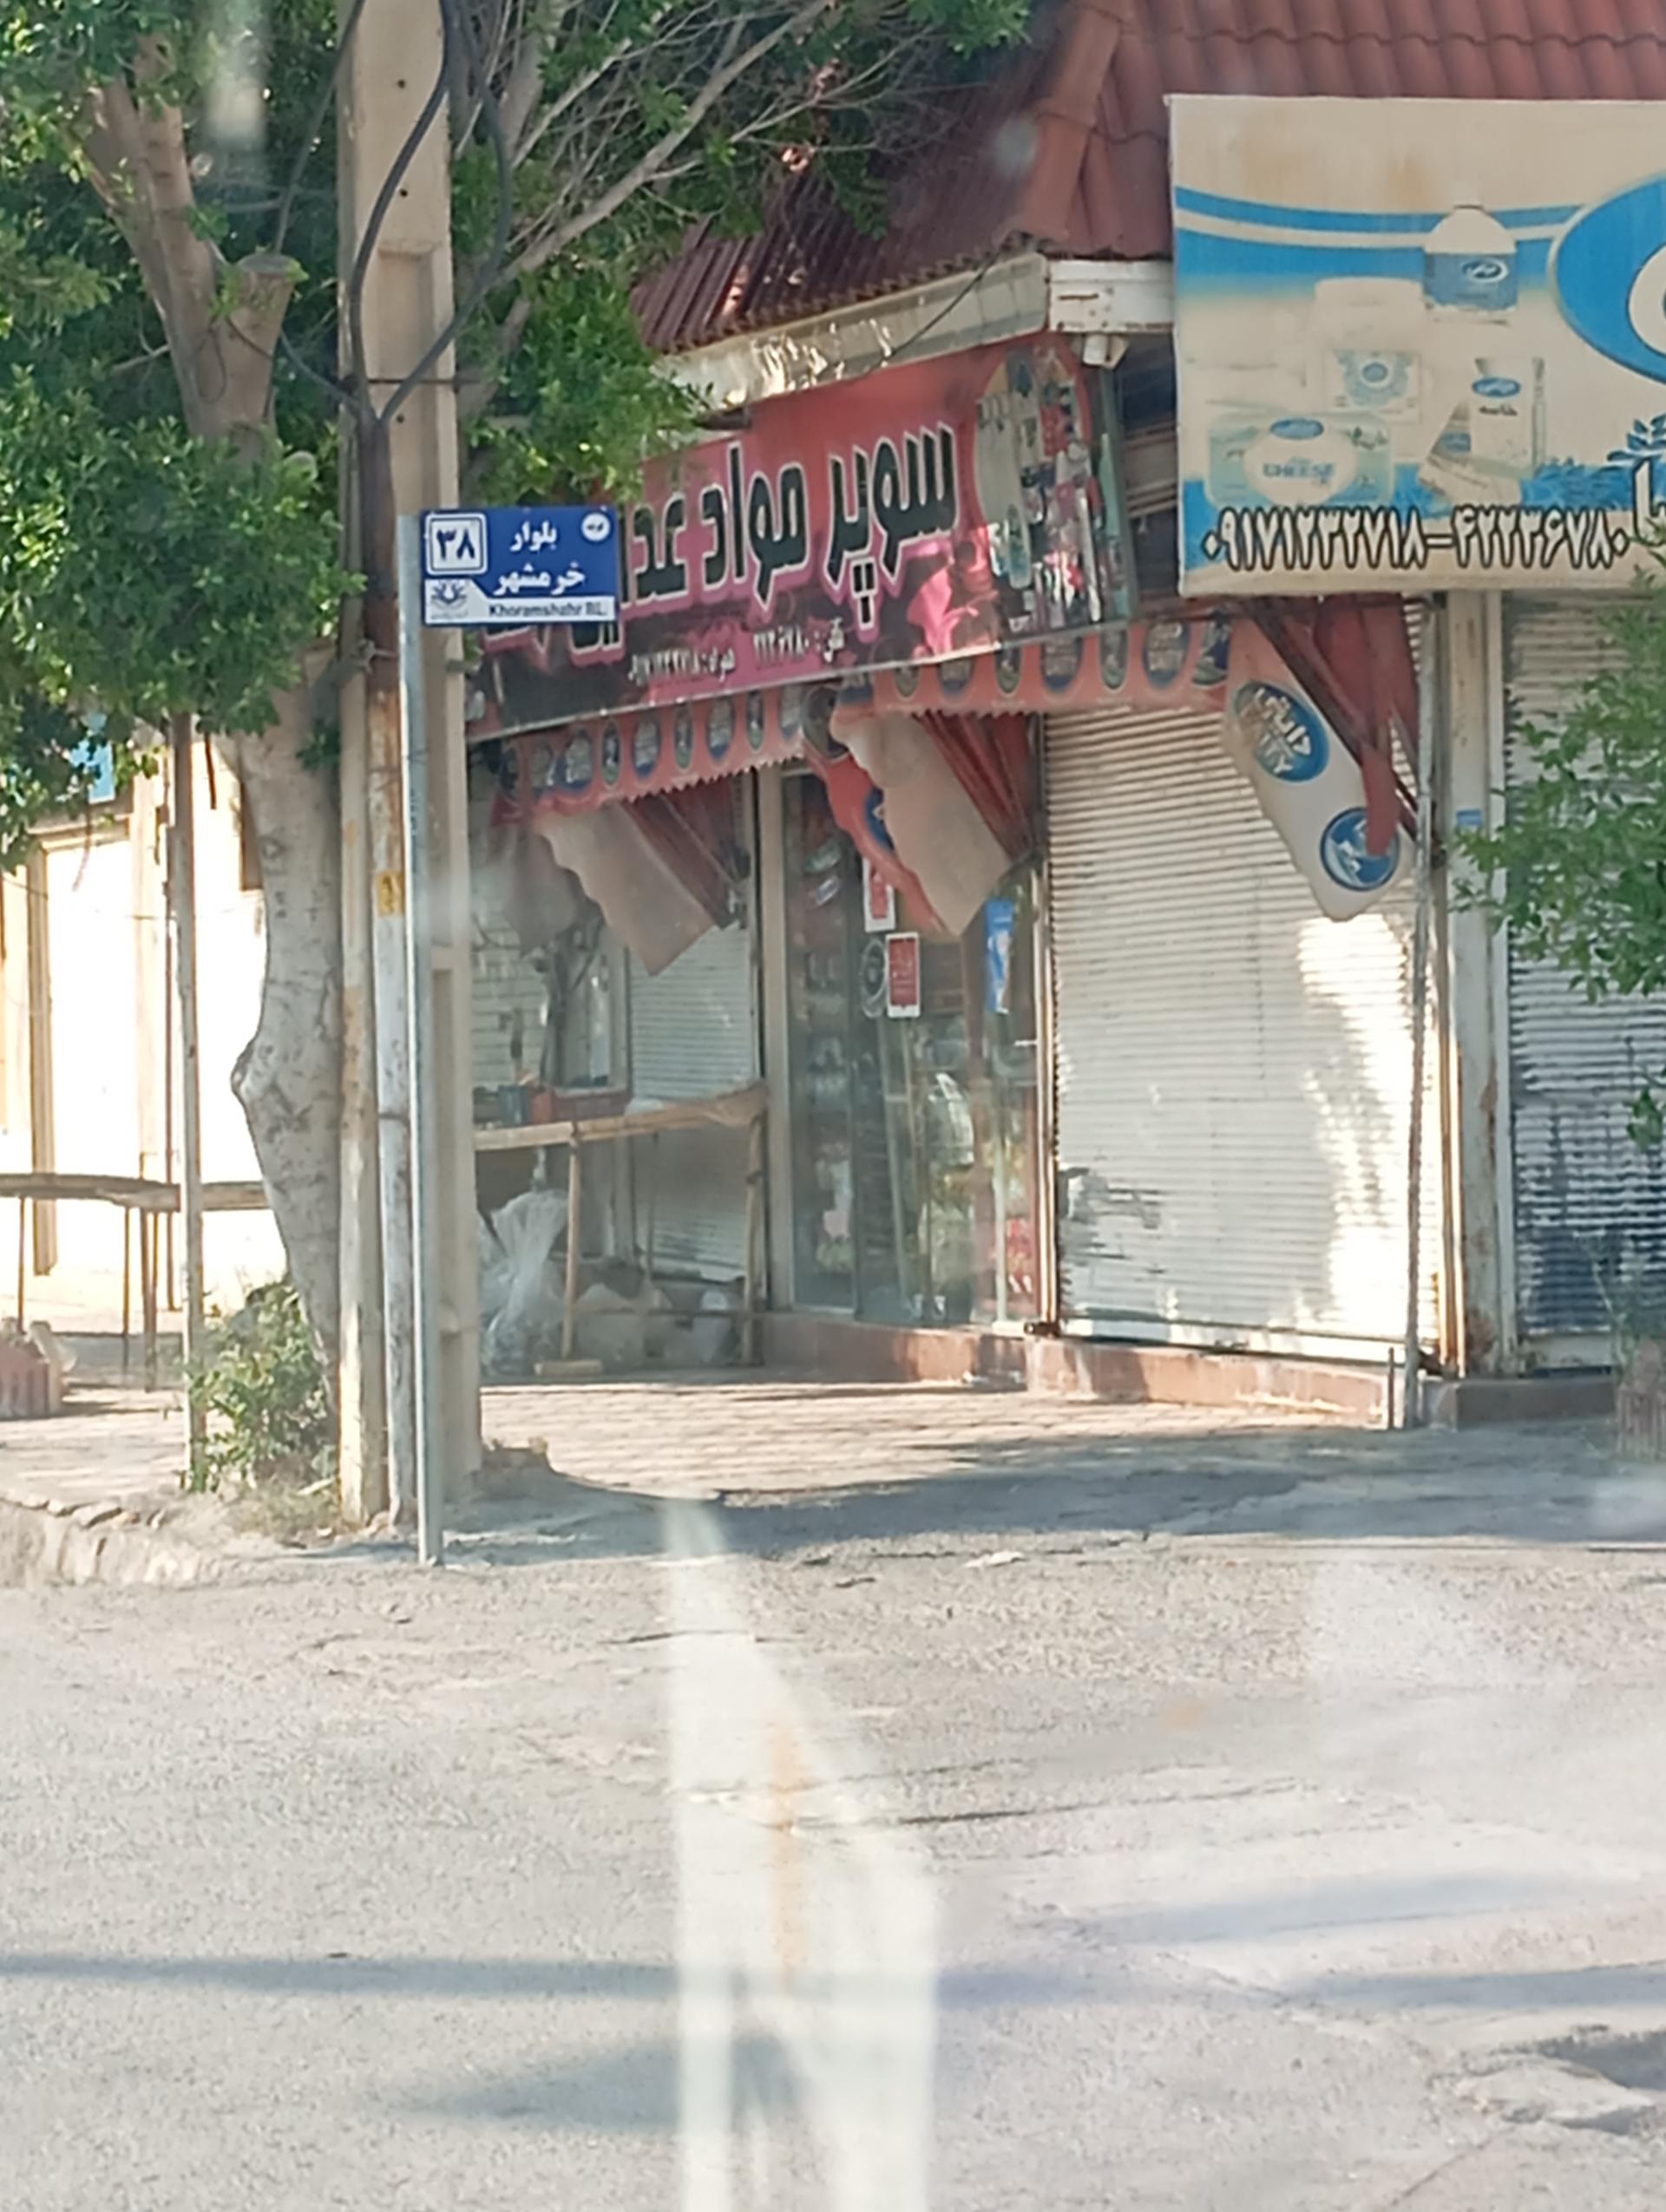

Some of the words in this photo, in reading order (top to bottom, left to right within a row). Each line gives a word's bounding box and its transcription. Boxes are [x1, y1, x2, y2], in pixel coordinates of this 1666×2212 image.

[510, 520, 558, 553] بلوار
[700, 441, 810, 612] مواد
[823, 421, 959, 629] سوپر
[436, 529, 476, 560] ۳۸
[493, 561, 586, 596] خرمشهر
[489, 601, 583, 617] Khoramshahr
